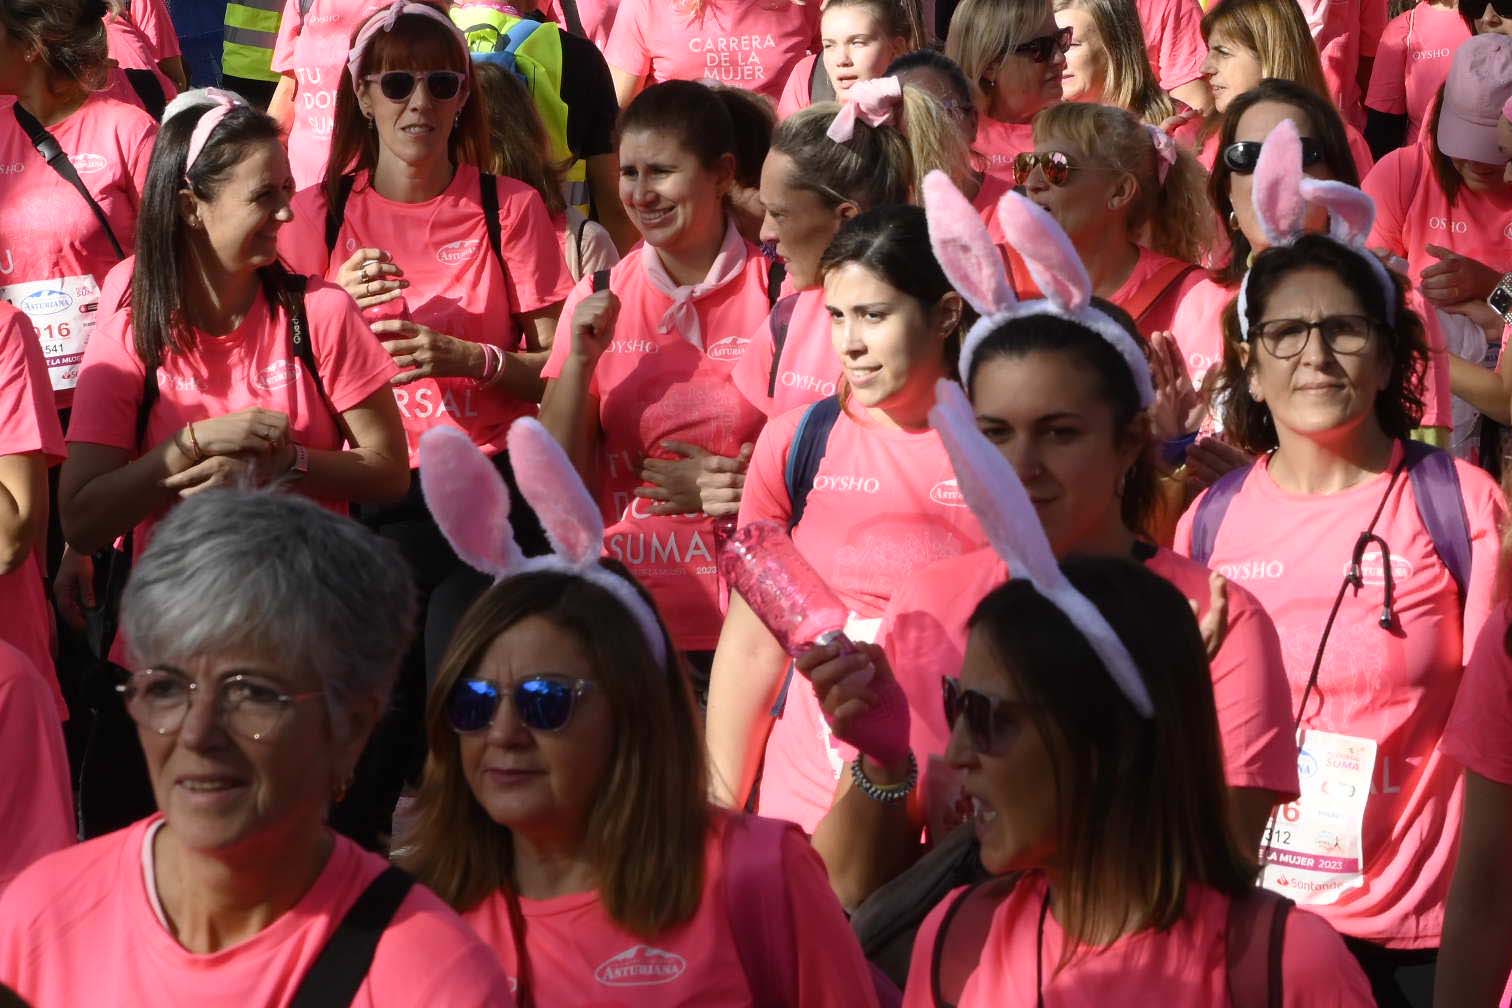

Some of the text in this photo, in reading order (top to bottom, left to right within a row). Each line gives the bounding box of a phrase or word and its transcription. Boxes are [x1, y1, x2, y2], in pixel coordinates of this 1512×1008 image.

[688, 33, 776, 53] CARRERA
[705, 51, 761, 67] DE LA
[1412, 47, 1451, 62] OYSHO
[297, 67, 321, 86] TU
[703, 66, 766, 81] MUJER
[391, 387, 478, 420] RSAL
[812, 475, 880, 494] OYSHO
[610, 531, 712, 565] SUMA
[1219, 560, 1285, 580] OYSHO
[1278, 852, 1315, 869] MUJER
